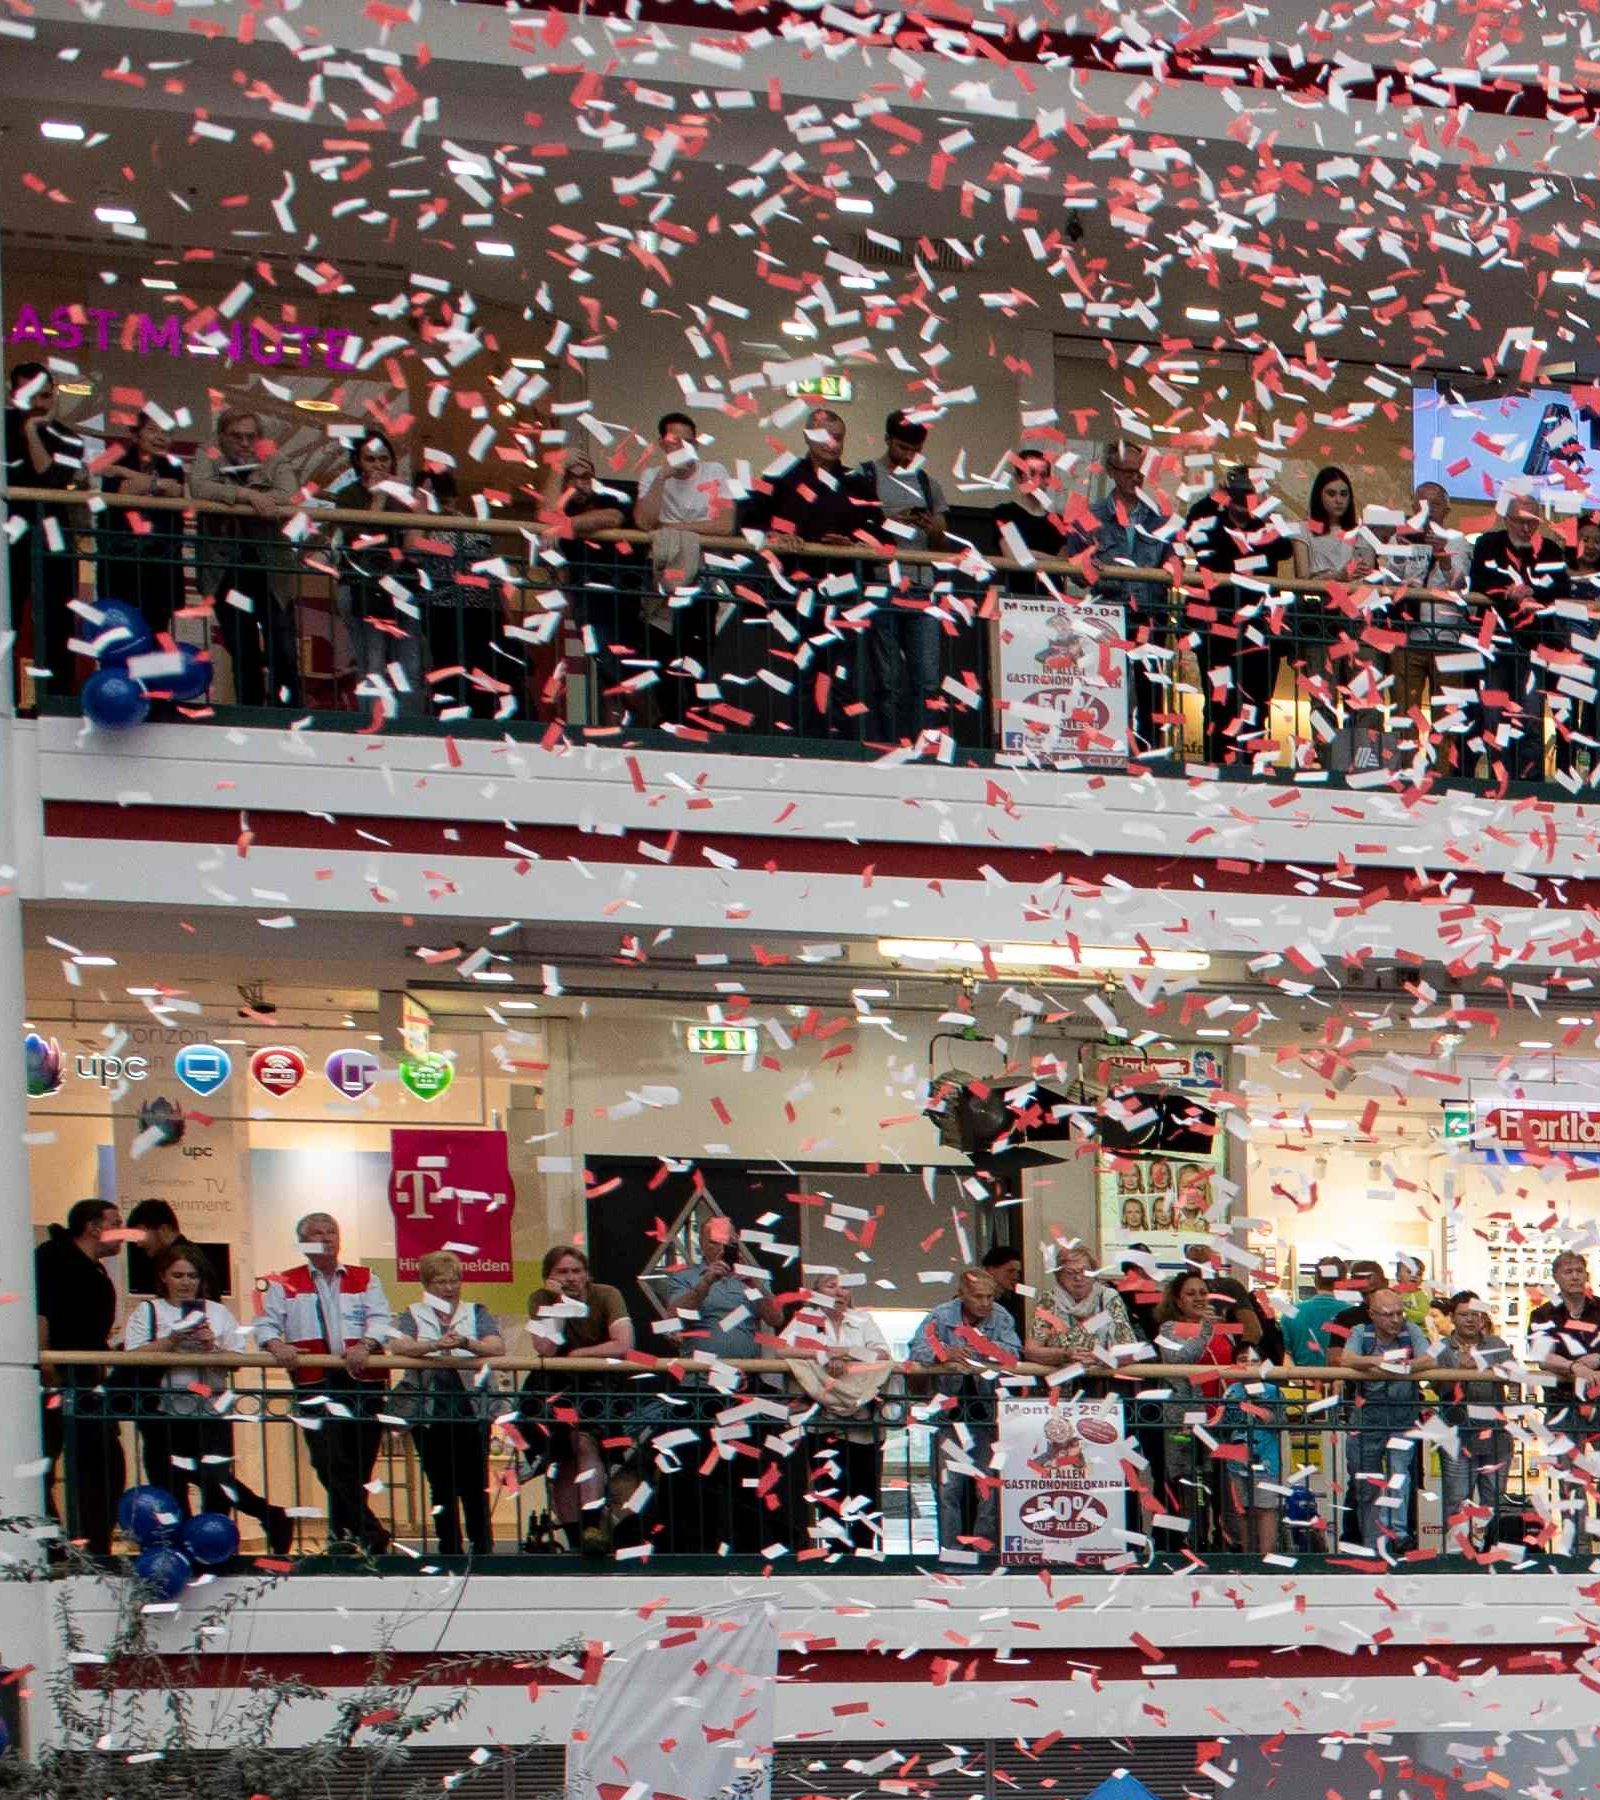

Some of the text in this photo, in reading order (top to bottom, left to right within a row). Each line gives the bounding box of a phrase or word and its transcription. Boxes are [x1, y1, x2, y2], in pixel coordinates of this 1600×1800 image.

[2, 304, 118, 351] AST
[1072, 605, 1120, 617] 29.04
[128, 1025, 210, 1044] orizon
[75, 1055, 148, 1089] upc
[183, 1146, 213, 1160] upc
[205, 1178, 228, 1193] TV
[1004, 1404, 1073, 1417] Montg
[1056, 1469, 1086, 1479] ALLEN
[1033, 1521, 1089, 1532] AUF ALLES
